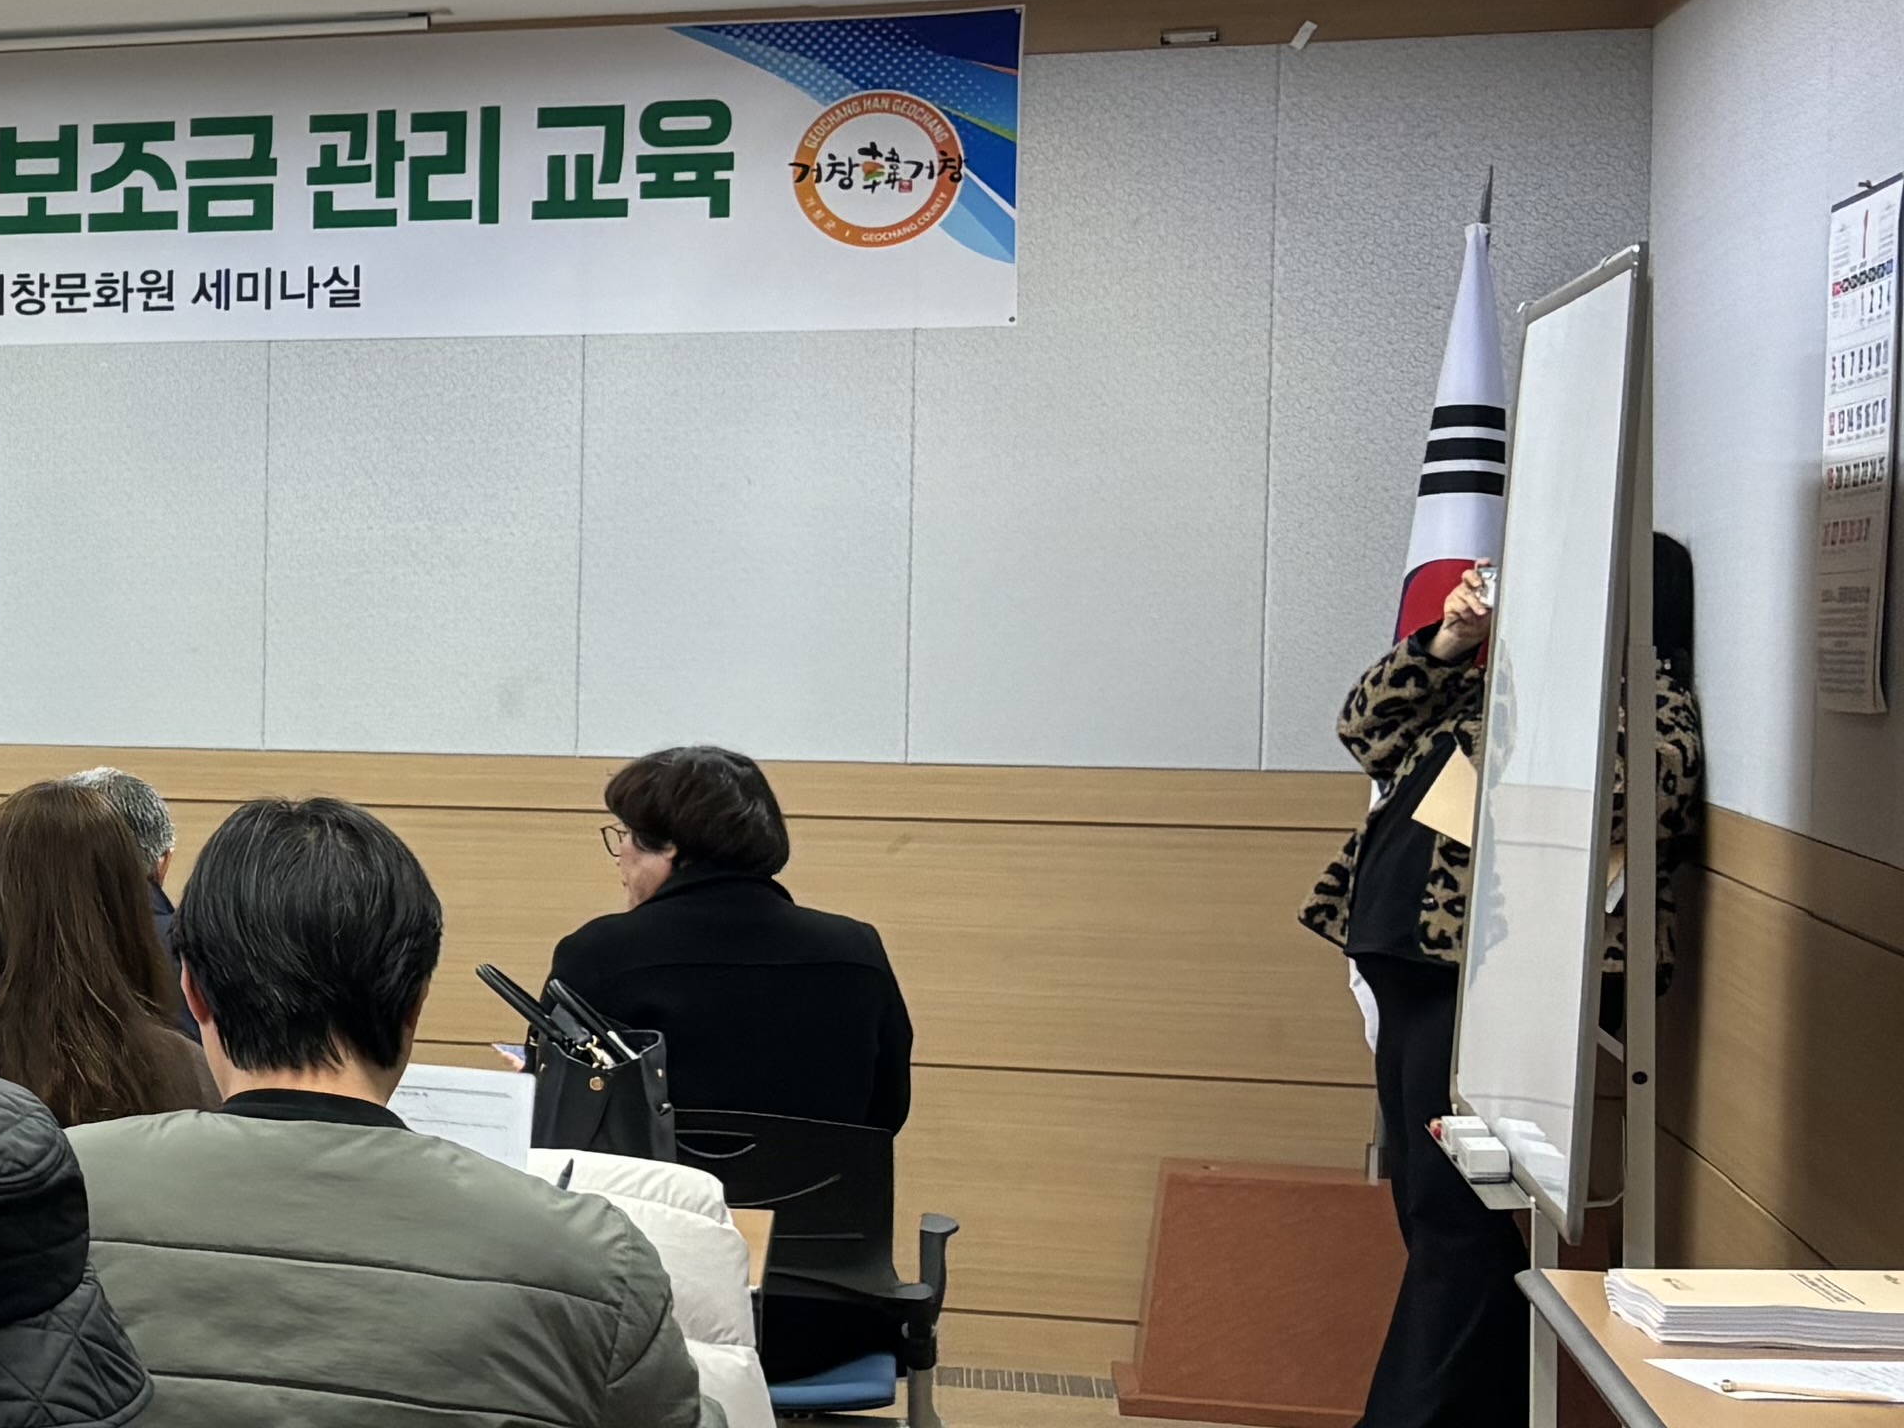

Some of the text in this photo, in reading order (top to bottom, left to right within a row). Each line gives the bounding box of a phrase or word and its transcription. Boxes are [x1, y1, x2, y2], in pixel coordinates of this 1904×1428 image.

[804, 97, 950, 150] GEOCHANG HAN GEOCHANG
[306, 105, 502, 230] 관리
[531, 98, 735, 221] 교육
[861, 222, 917, 243] GEOCHANG
[190, 264, 363, 312] 세미나실
